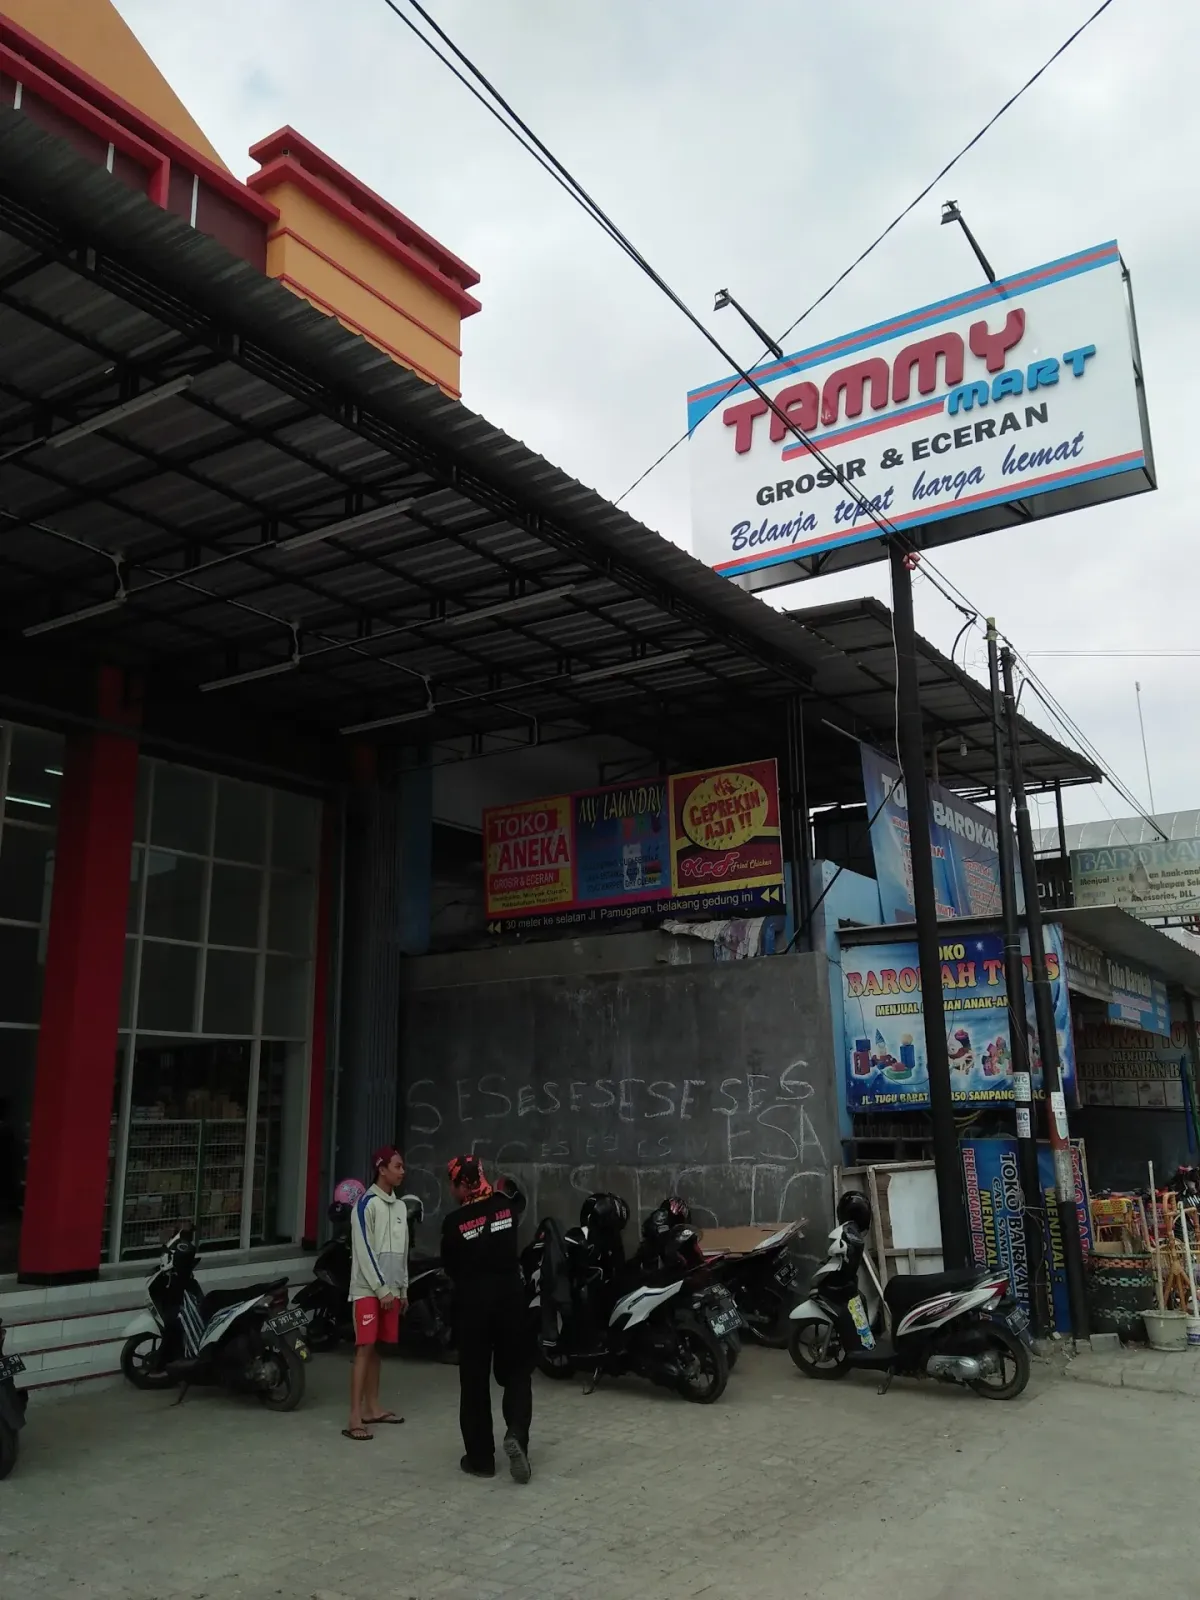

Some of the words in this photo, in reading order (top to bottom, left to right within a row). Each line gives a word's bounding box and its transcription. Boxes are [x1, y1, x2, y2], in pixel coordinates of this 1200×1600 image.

[723, 308, 1025, 455] TAMMY
[947, 344, 1096, 416] MART
[756, 458, 866, 507] GROSIR
[880, 447, 904, 471] &
[912, 402, 1049, 462] ECERAN
[730, 512, 818, 552] Belanja
[834, 485, 895, 525] tepat
[911, 468, 985, 505] harga
[1001, 431, 1084, 475] hemat
[579, 796, 600, 829] MY
[603, 785, 665, 821] LAUNDRY
[881, 773, 908, 811] TO
[494, 812, 549, 839] TOKO
[705, 818, 736, 840] AJA
[497, 831, 571, 873] ANEKA
[1077, 841, 1200, 874] BAROKA
[506, 919, 516, 930] 30
[518, 917, 541, 929] meter
[543, 916, 554, 926] ke
[555, 911, 586, 925] selatan
[600, 903, 653, 920] Pamugaran,
[656, 899, 700, 915] belakang
[702, 894, 739, 911] gedung
[741, 892, 754, 905] ini
[847, 960, 977, 998] BAROAH
[876, 1002, 919, 1018] MENJUAL
[874, 1093, 897, 1105] TUGU
[901, 1092, 929, 1103] BARAT
[969, 1089, 1015, 1101] SAMPANG
[1013, 1076, 1028, 1084] WC
[1017, 1112, 1029, 1121] WC
[961, 1147, 983, 1234] PERLENGKAPAN
[1000, 1151, 1019, 1213] TOKO
[979, 1190, 999, 1266] MENJUAL
[1044, 1191, 1066, 1271] MENJUAL
[971, 1233, 986, 1264] BABY
